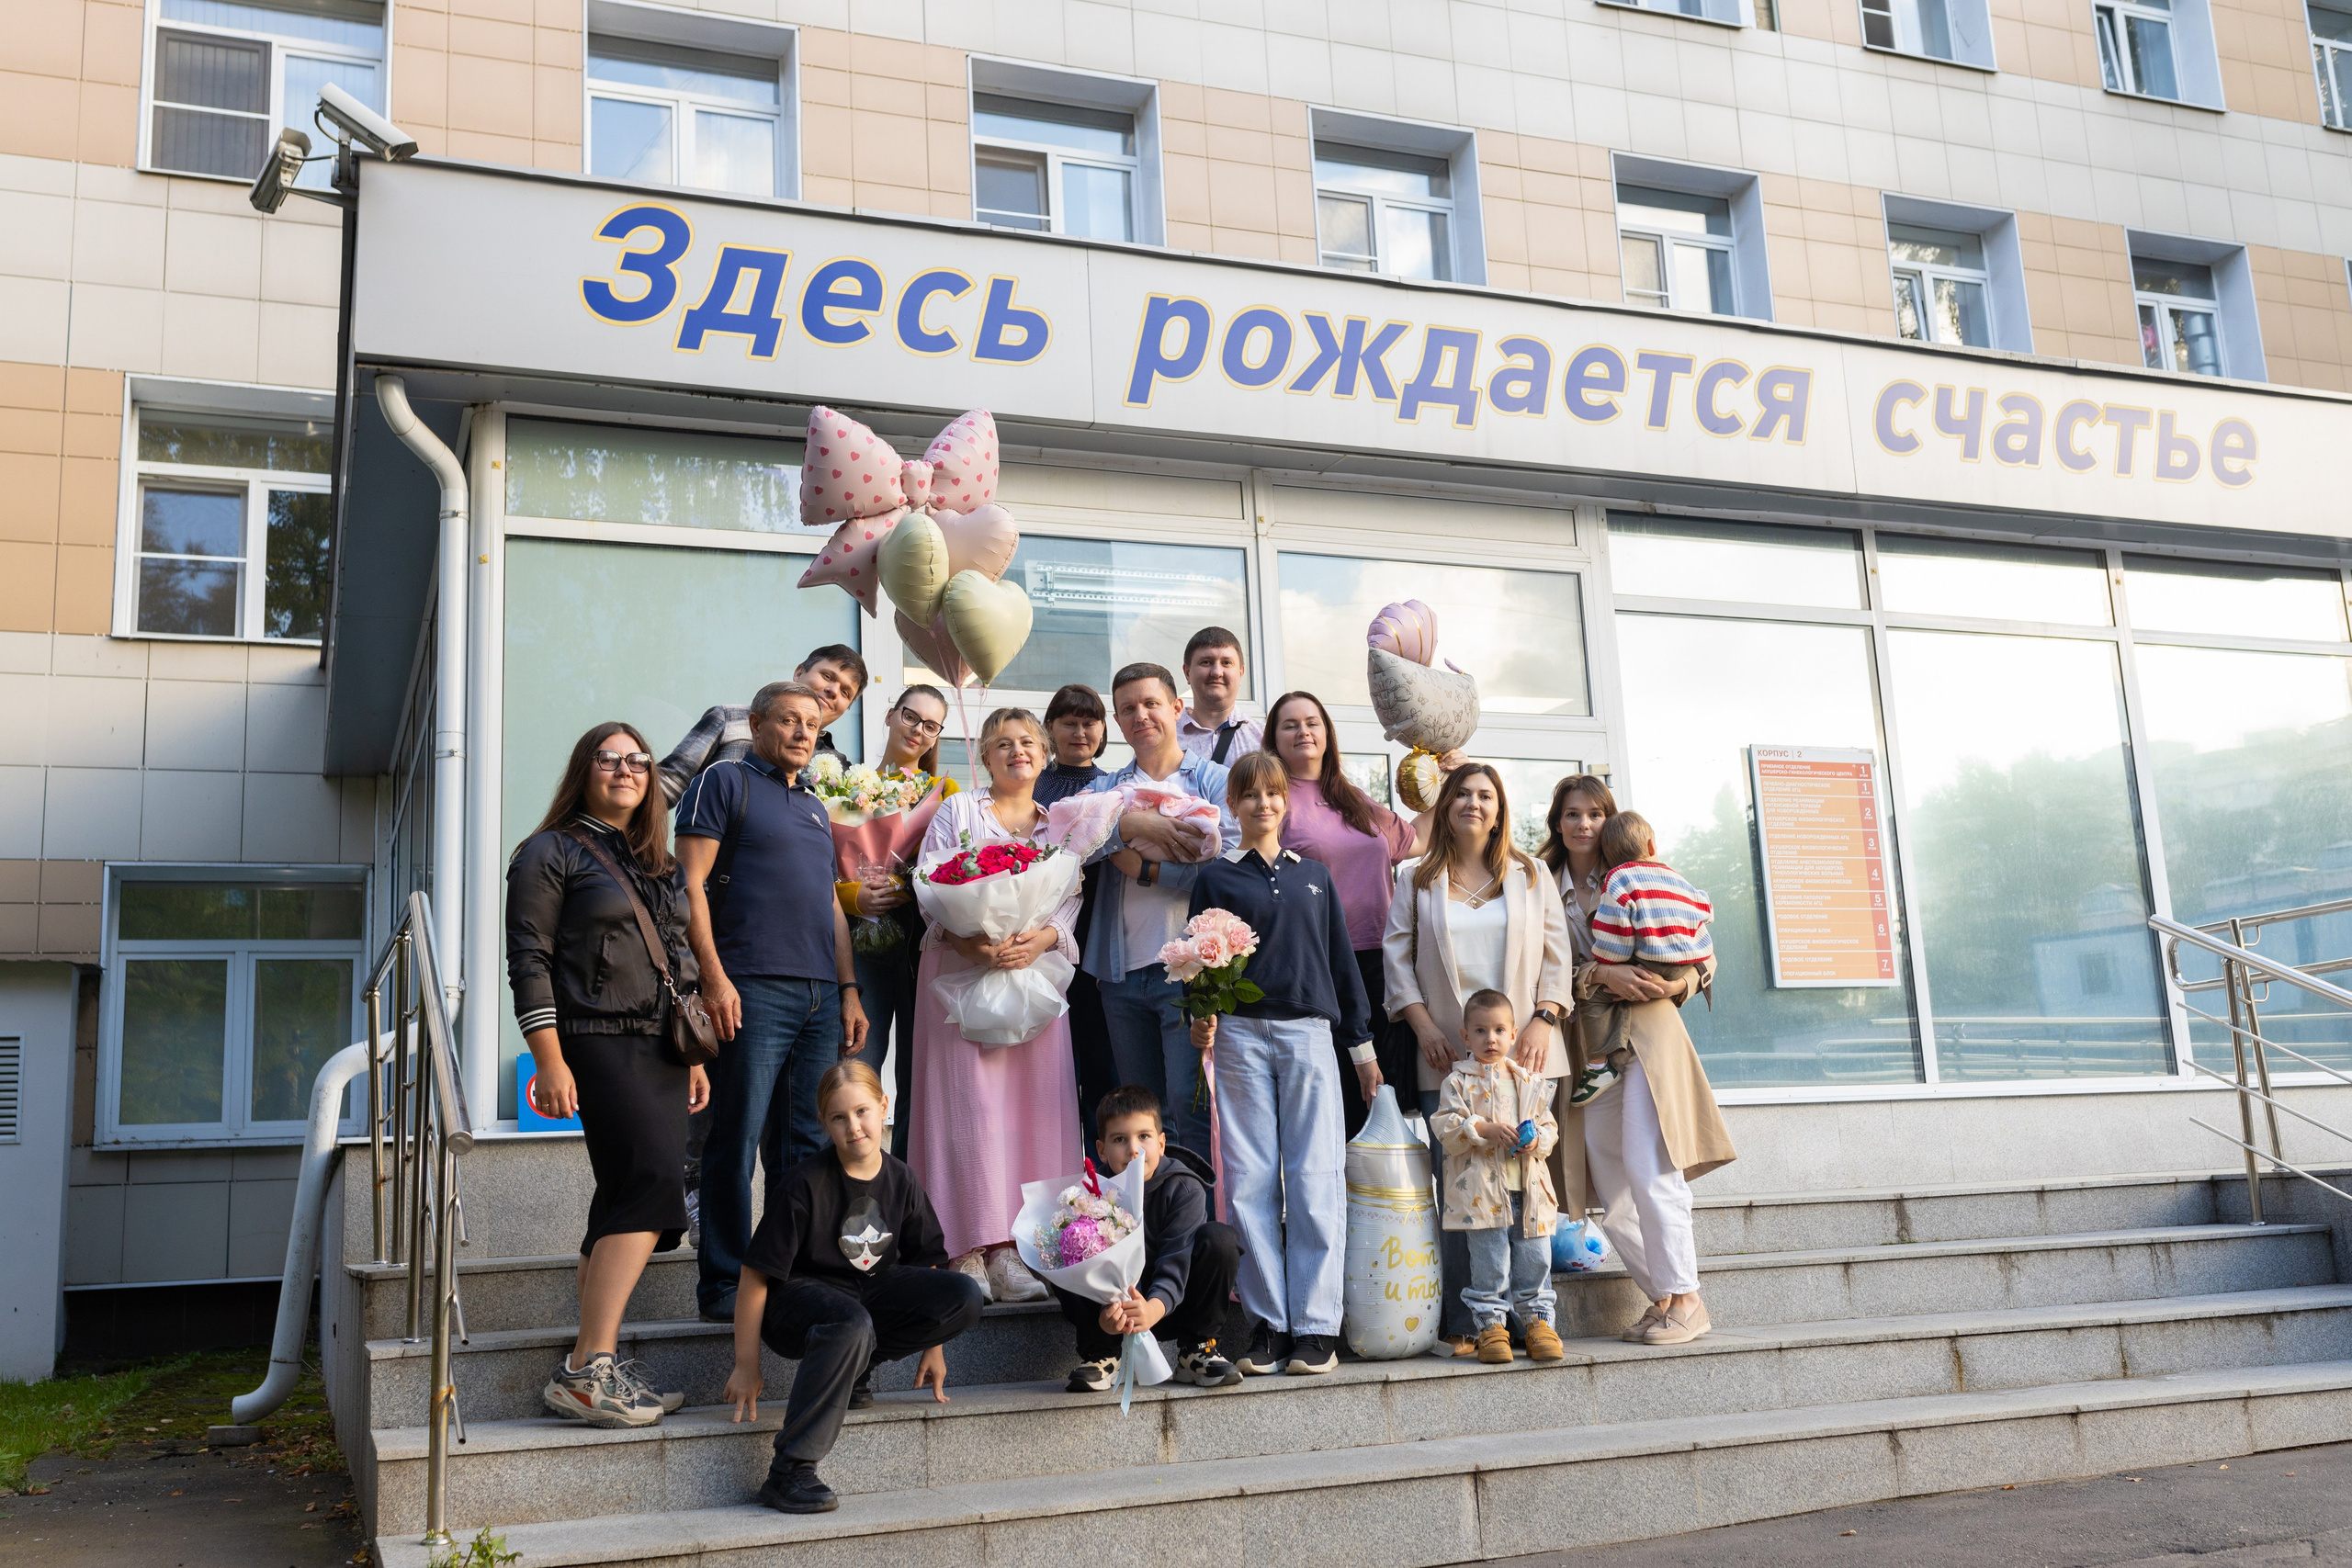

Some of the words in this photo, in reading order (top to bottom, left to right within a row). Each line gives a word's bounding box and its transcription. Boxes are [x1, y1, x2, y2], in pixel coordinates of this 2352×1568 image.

[578, 201, 1053, 367] Здесь
[1122, 292, 1815, 445] рождается
[1872, 379, 2259, 488] счастье
[1862, 783, 1868, 791] 1
[1865, 807, 1871, 816] 2
[1869, 839, 1874, 847] 3
[580, 835, 596, 850] DAVID
[594, 848, 611, 866] JONES
[1871, 868, 1878, 877] 4
[1875, 894, 1881, 903] 5
[1878, 924, 1884, 932] 6
[1882, 959, 1888, 968] 7
[1380, 1235, 1438, 1269] Вот
